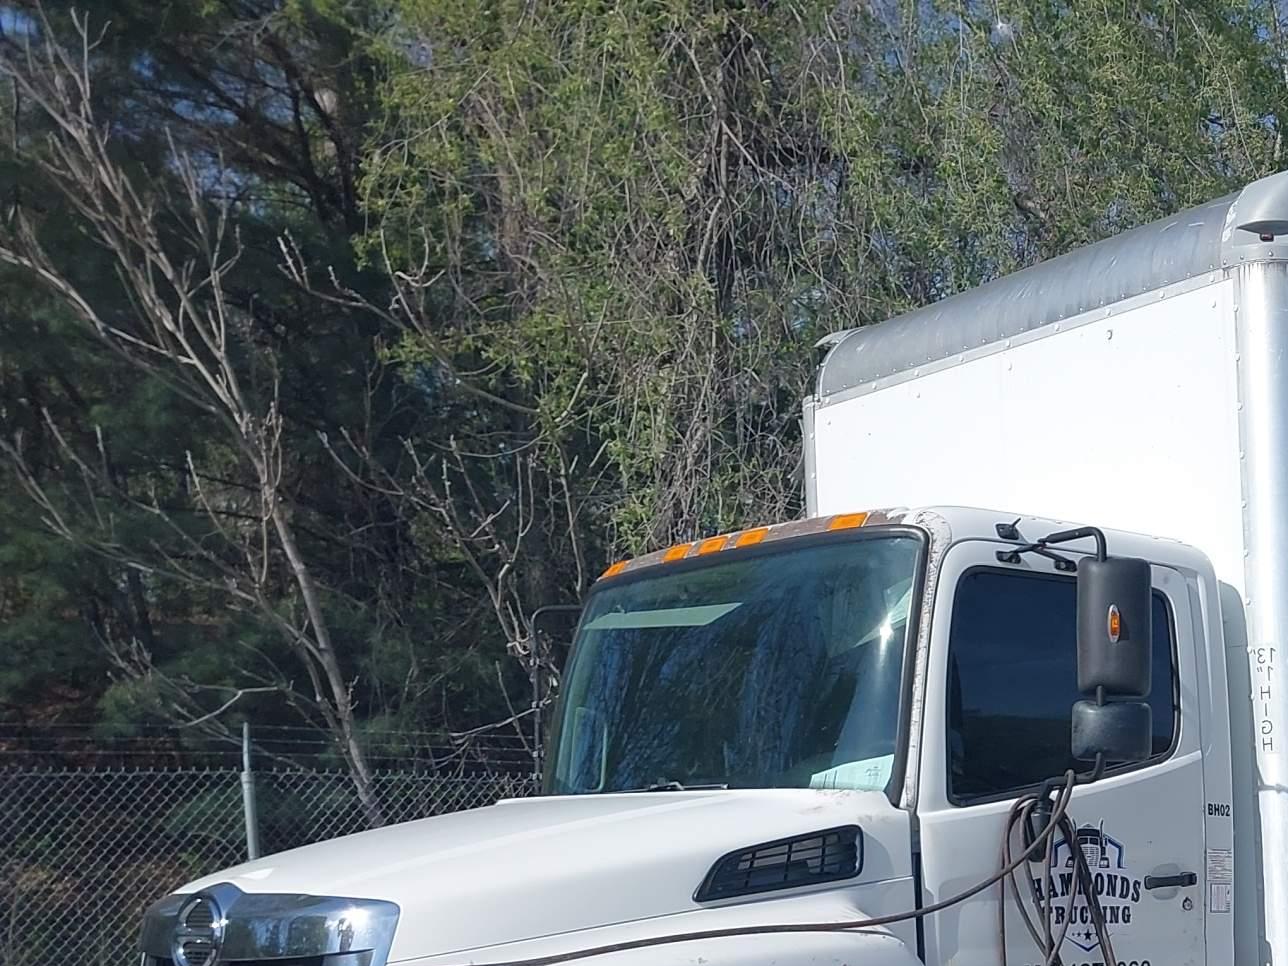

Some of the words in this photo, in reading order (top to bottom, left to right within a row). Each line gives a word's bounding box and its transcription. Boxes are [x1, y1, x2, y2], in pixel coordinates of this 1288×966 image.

[1208, 803, 1231, 816] BH02
[1032, 872, 1141, 902] HAMONDS
[1042, 905, 1131, 924] RUCING
